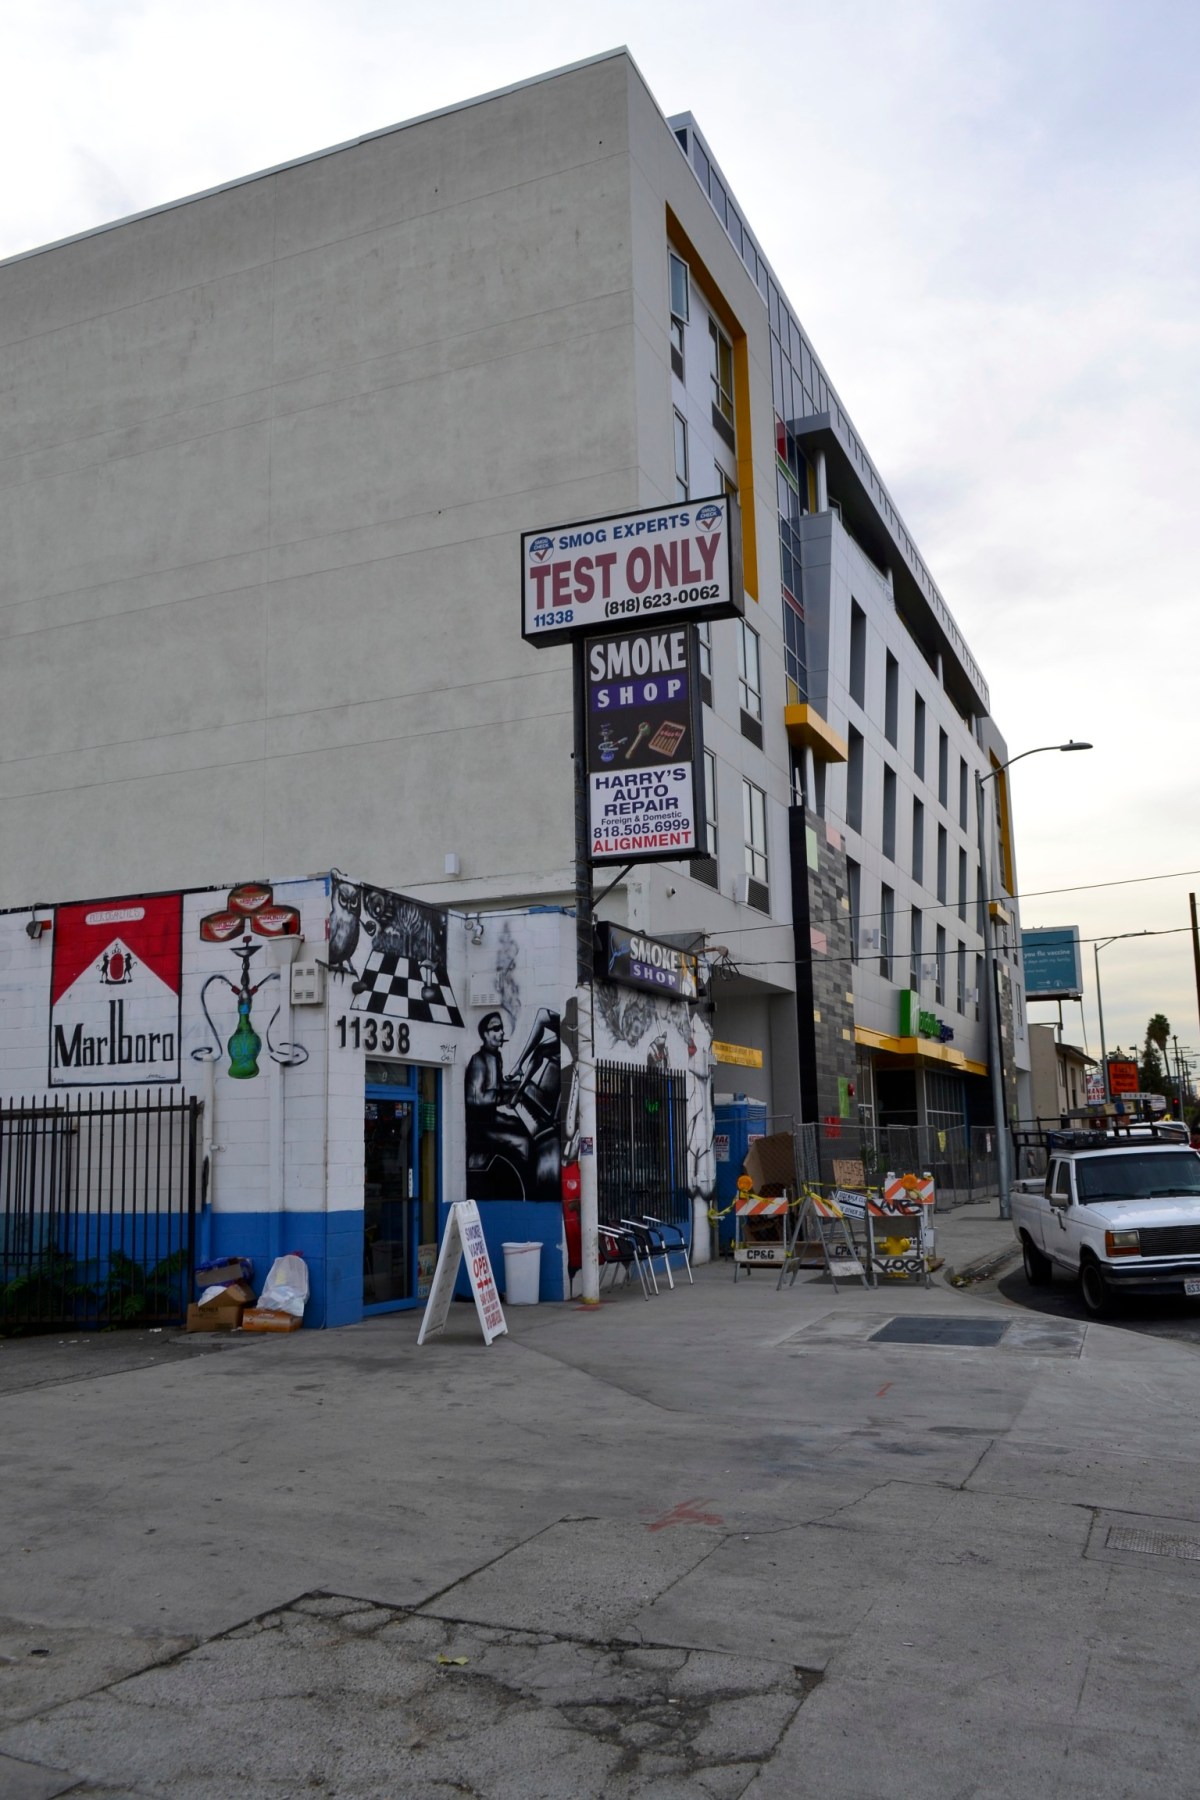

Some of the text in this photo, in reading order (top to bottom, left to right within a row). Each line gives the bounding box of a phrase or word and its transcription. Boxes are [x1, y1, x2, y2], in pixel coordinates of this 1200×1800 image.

[559, 513, 690, 550] SMOG EXPERTS
[530, 533, 721, 610] TEST ONLY
[534, 584, 720, 627] 11338 (818) 623-0062
[590, 631, 687, 681] SMOKE
[597, 679, 681, 708] SHOP
[595, 768, 686, 790] HARRY'S
[612, 784, 669, 802] AUTO
[604, 797, 679, 816] REPAIR
[593, 818, 690, 838] 818.505.6999
[601, 811, 682, 826] Foreign & Domestic
[593, 831, 692, 853] ALIGNMENT
[630, 937, 678, 972] SMOKE
[633, 965, 676, 986] SHOP
[54, 999, 174, 1068] Marlboro
[335, 1015, 410, 1055] 11338
[473, 1255, 489, 1278] OPEN
[747, 1250, 775, 1260] CP&G
